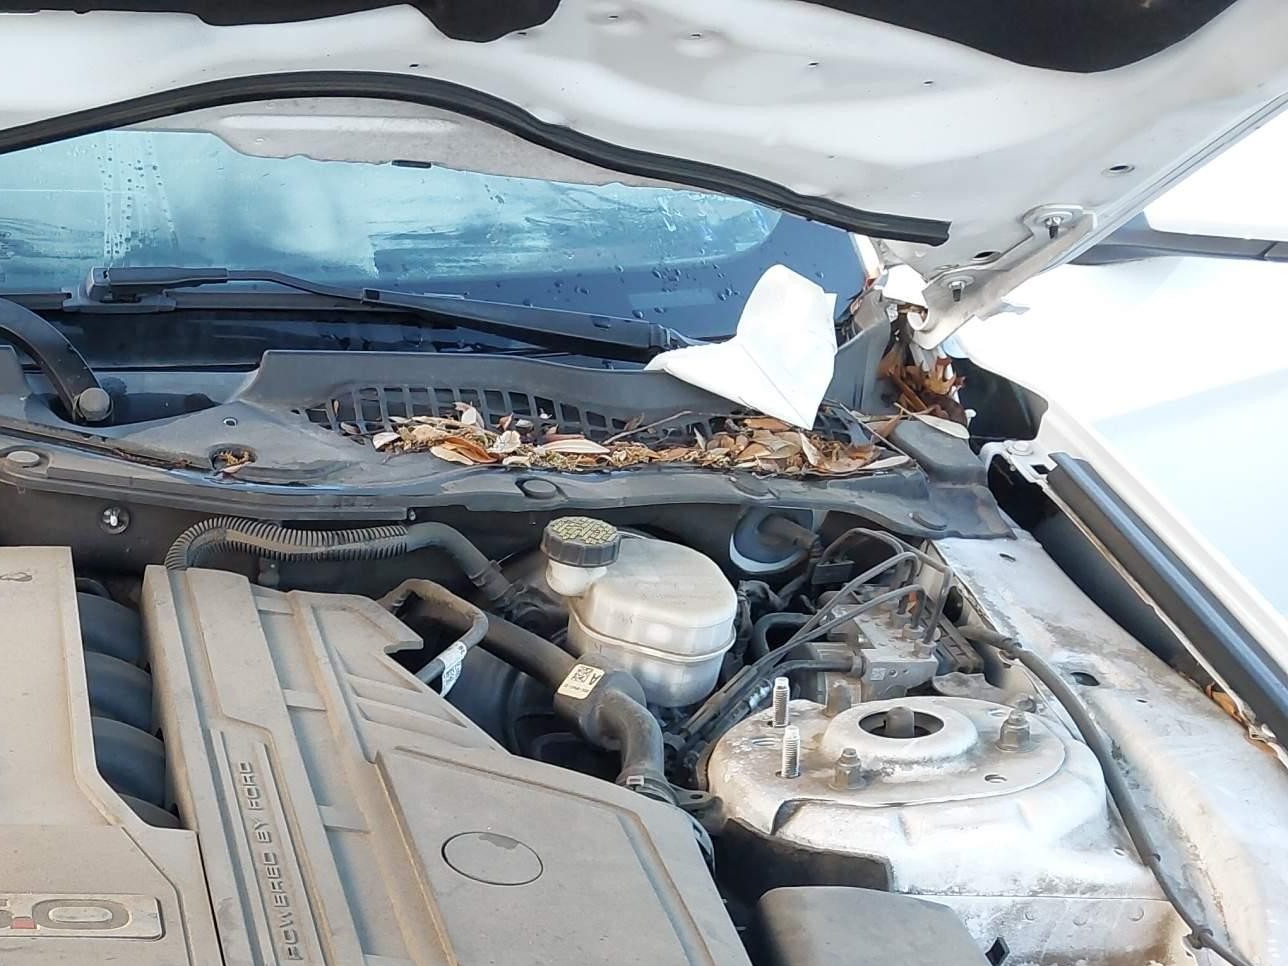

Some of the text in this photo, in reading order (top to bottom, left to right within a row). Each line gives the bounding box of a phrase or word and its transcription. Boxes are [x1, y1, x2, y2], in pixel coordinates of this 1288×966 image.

[240, 761, 304, 961] POWERED BY FORD
